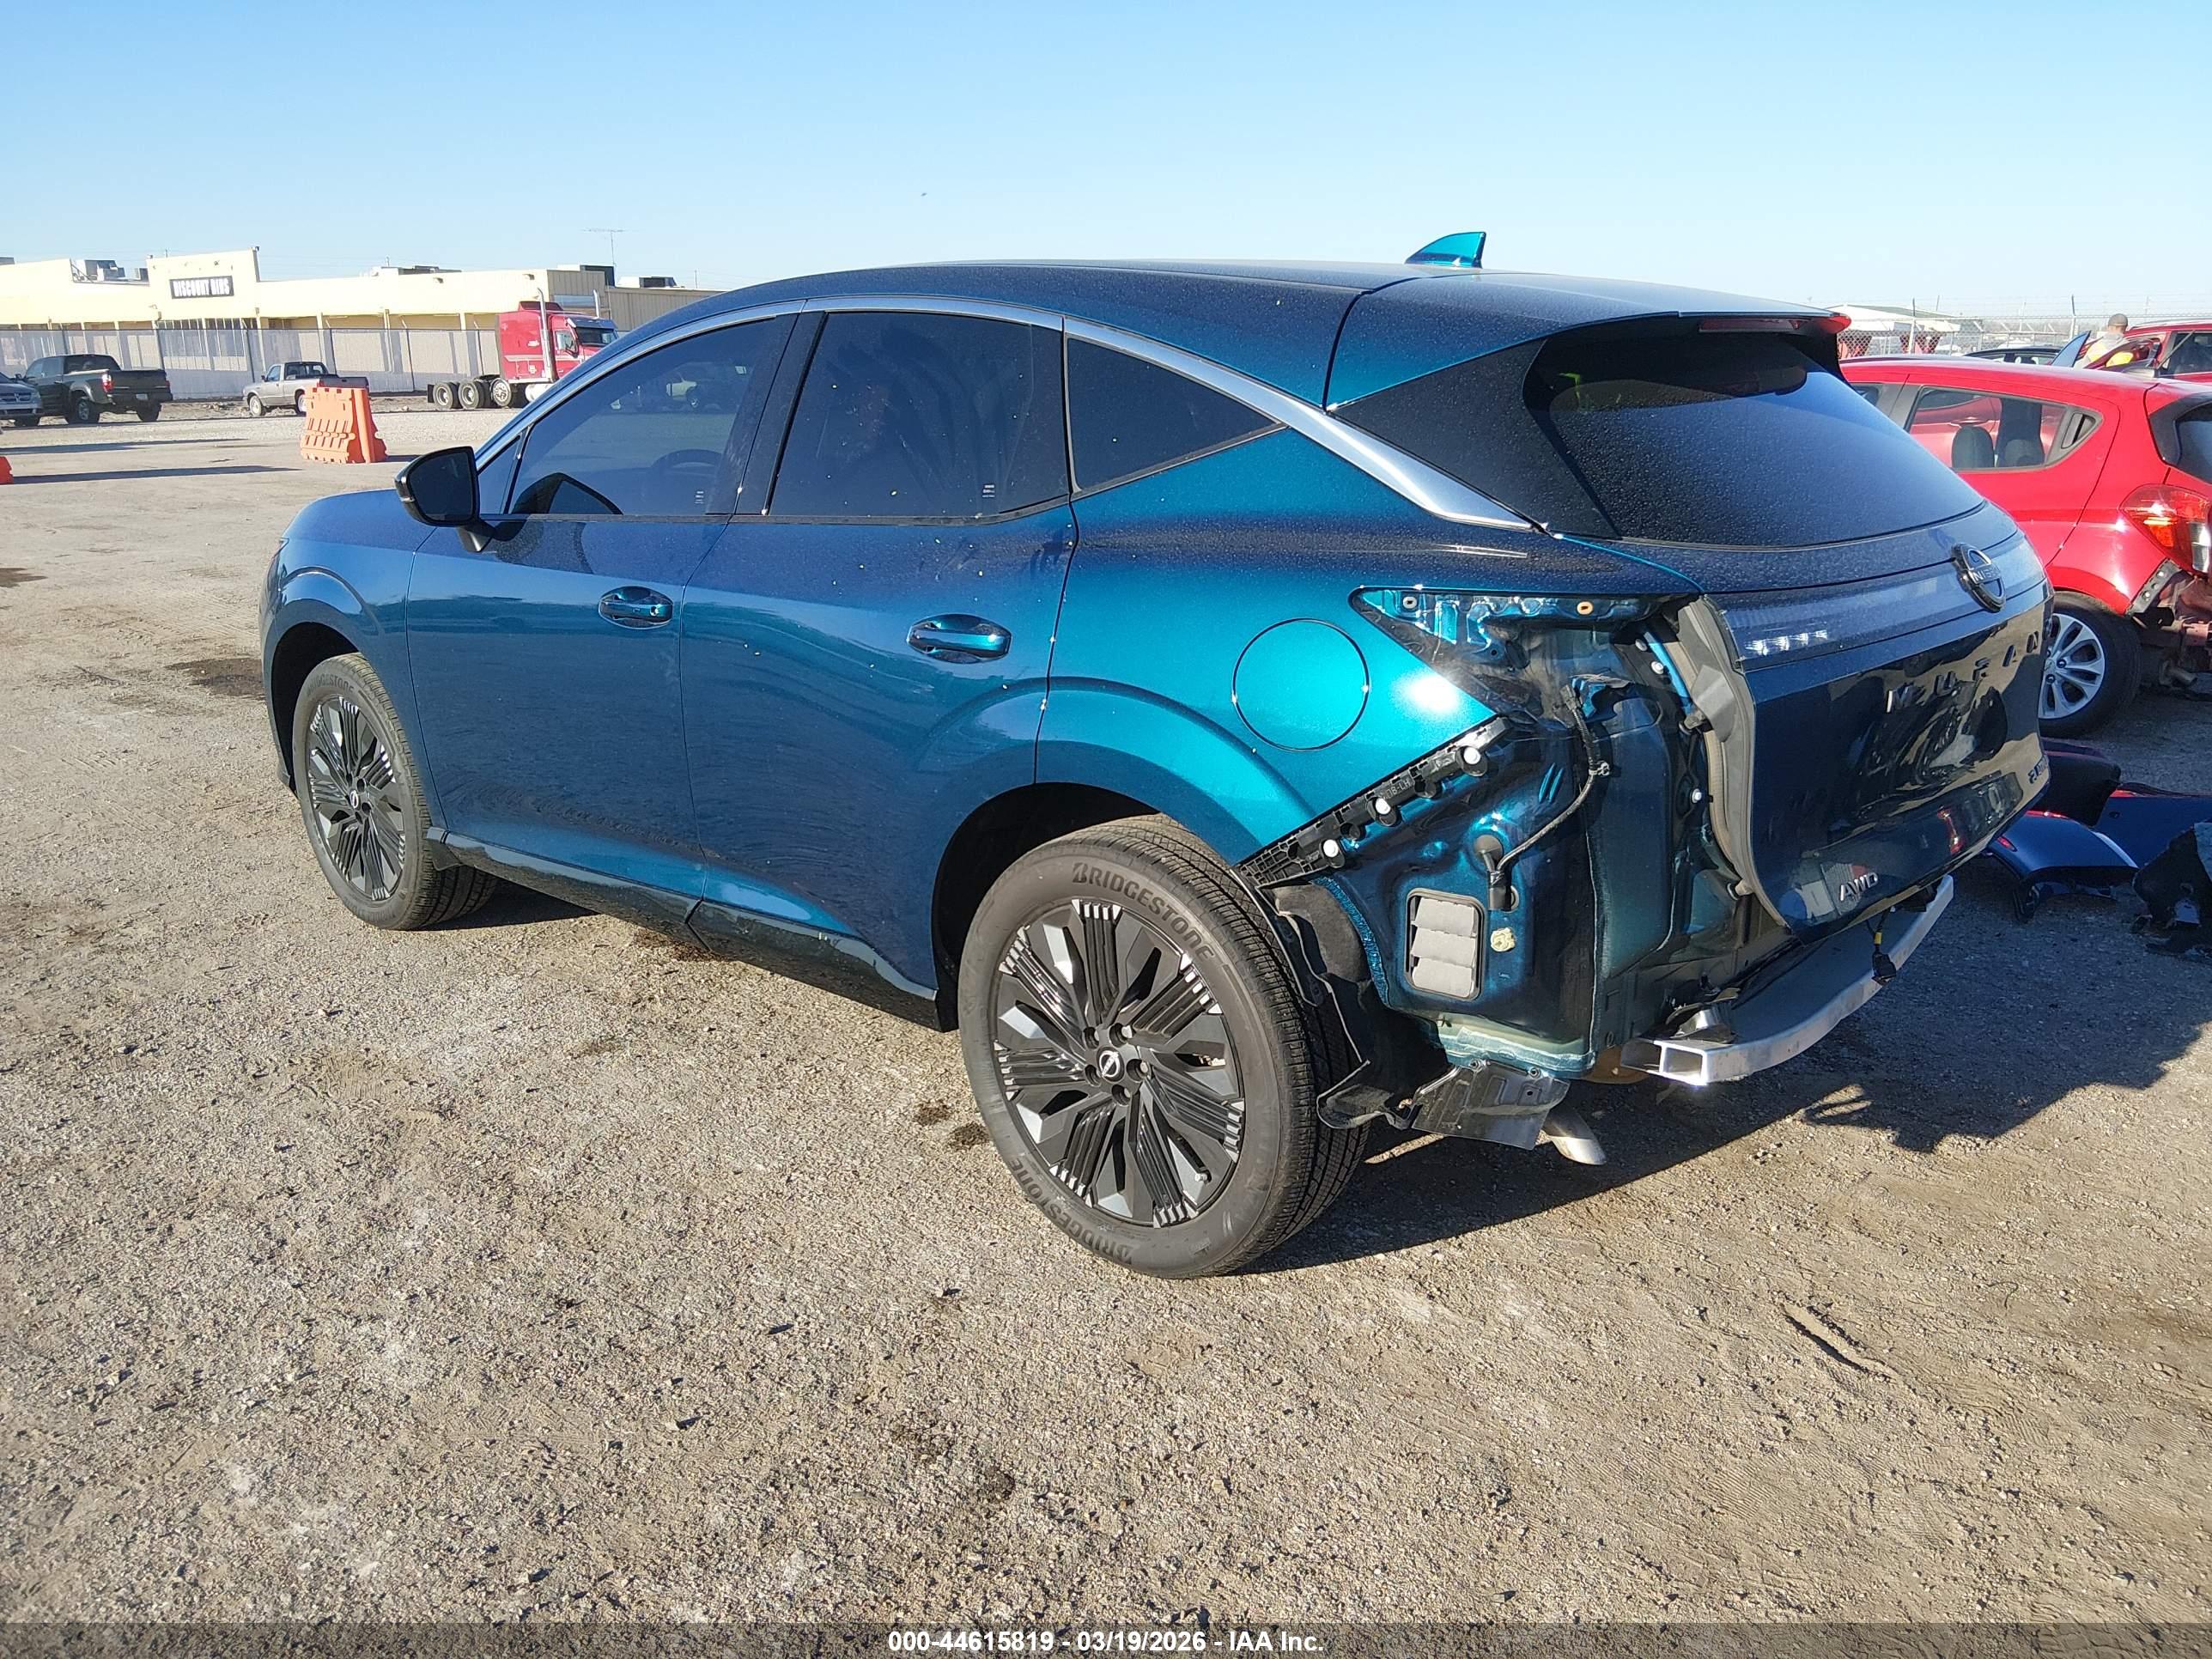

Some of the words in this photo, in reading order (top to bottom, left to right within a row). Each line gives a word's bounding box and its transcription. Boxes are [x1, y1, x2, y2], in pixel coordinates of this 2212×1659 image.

[173, 279, 210, 297] DISCOUNT
[308, 673, 355, 697] DGESTONE
[1839, 872, 1878, 901] AWD
[1073, 862, 1214, 960] BRIDGESTONE
[1010, 1158, 1133, 1266] BRIDGESTONE
